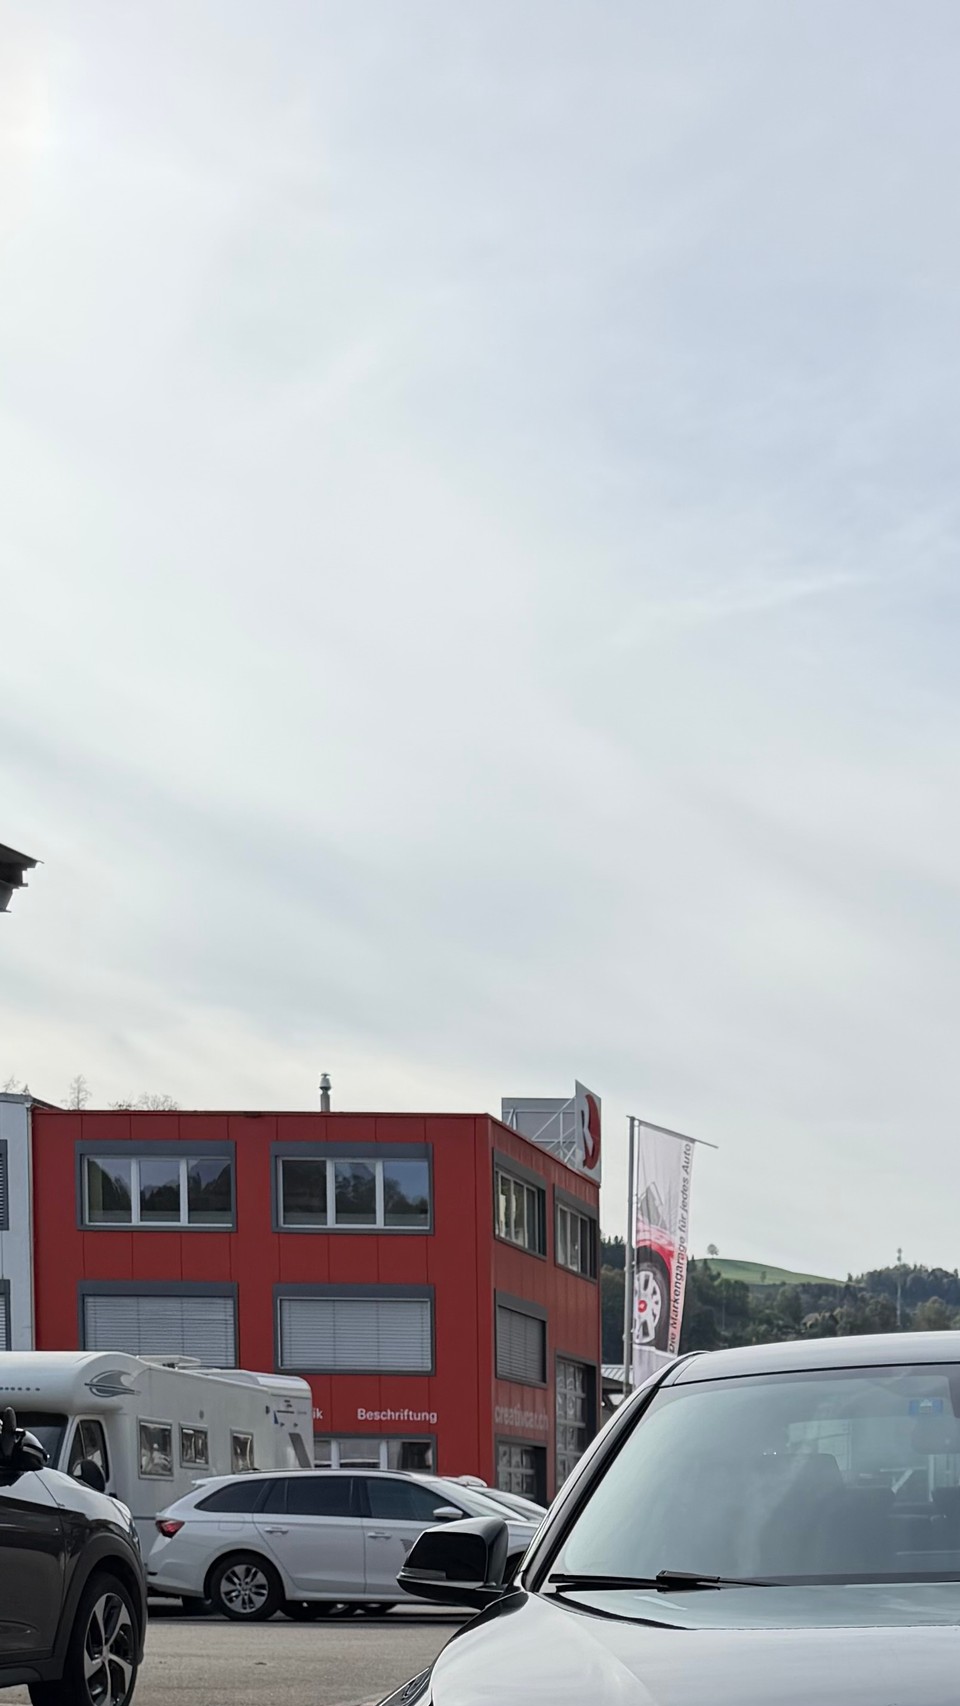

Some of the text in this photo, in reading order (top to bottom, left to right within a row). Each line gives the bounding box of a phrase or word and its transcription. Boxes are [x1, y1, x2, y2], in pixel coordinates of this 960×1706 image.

[668, 1143, 692, 1354] Die Markengarage für jedes Auto
[357, 1408, 438, 1424] Beschriftung
